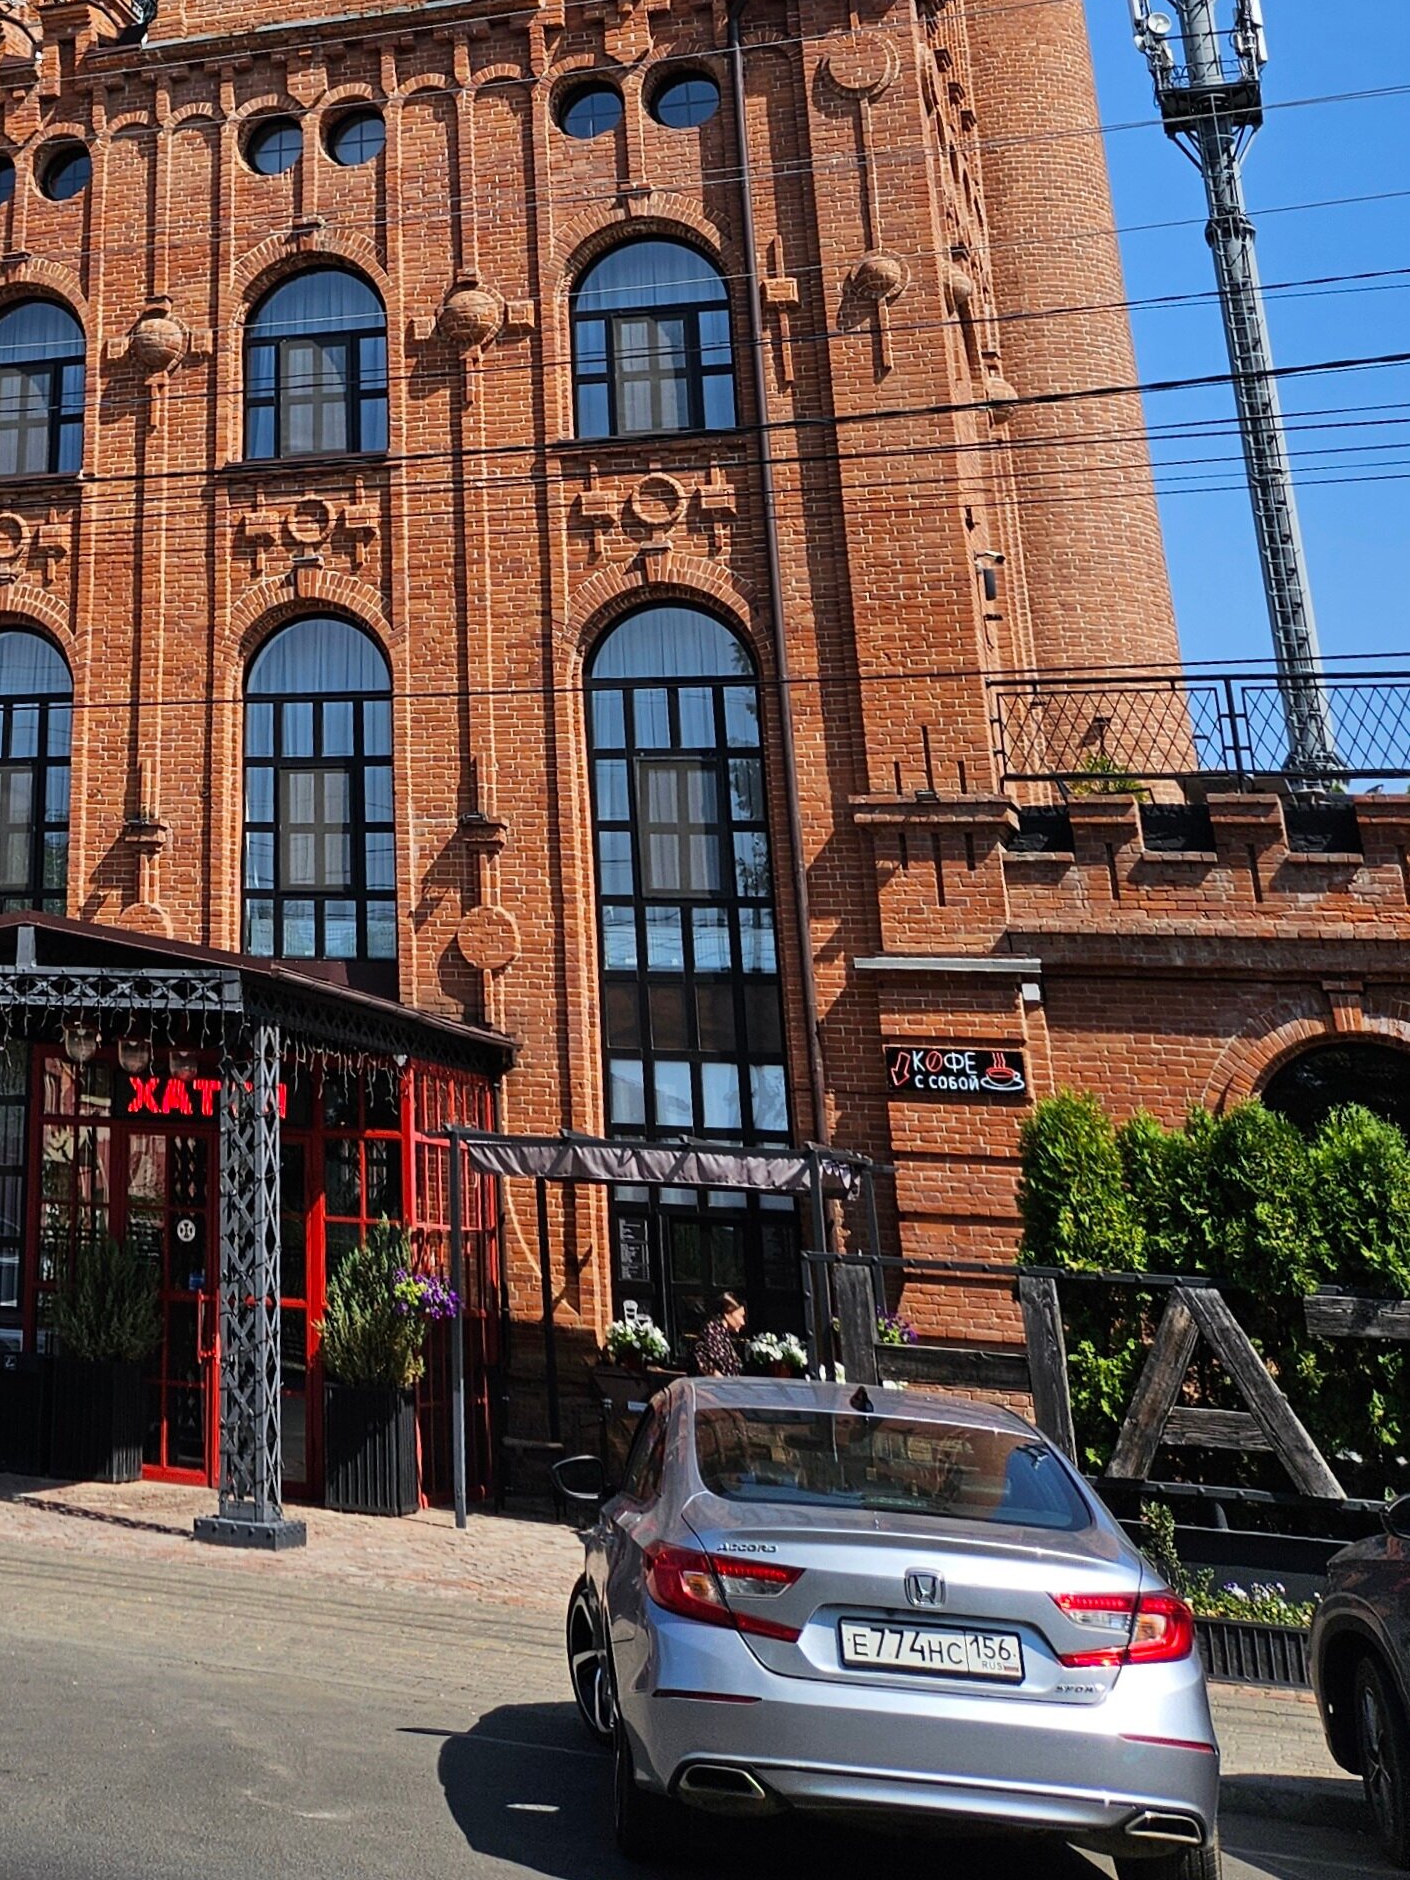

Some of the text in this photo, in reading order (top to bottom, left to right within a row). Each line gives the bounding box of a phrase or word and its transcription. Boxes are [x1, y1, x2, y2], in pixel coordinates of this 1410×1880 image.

[912, 1050, 978, 1075] КОФЕ
[127, 1076, 287, 1119] ХАТ
[716, 1541, 779, 1554] ACCORD
[852, 1627, 1012, 1666] Е774НС 156
[981, 1660, 1003, 1672] RUS
